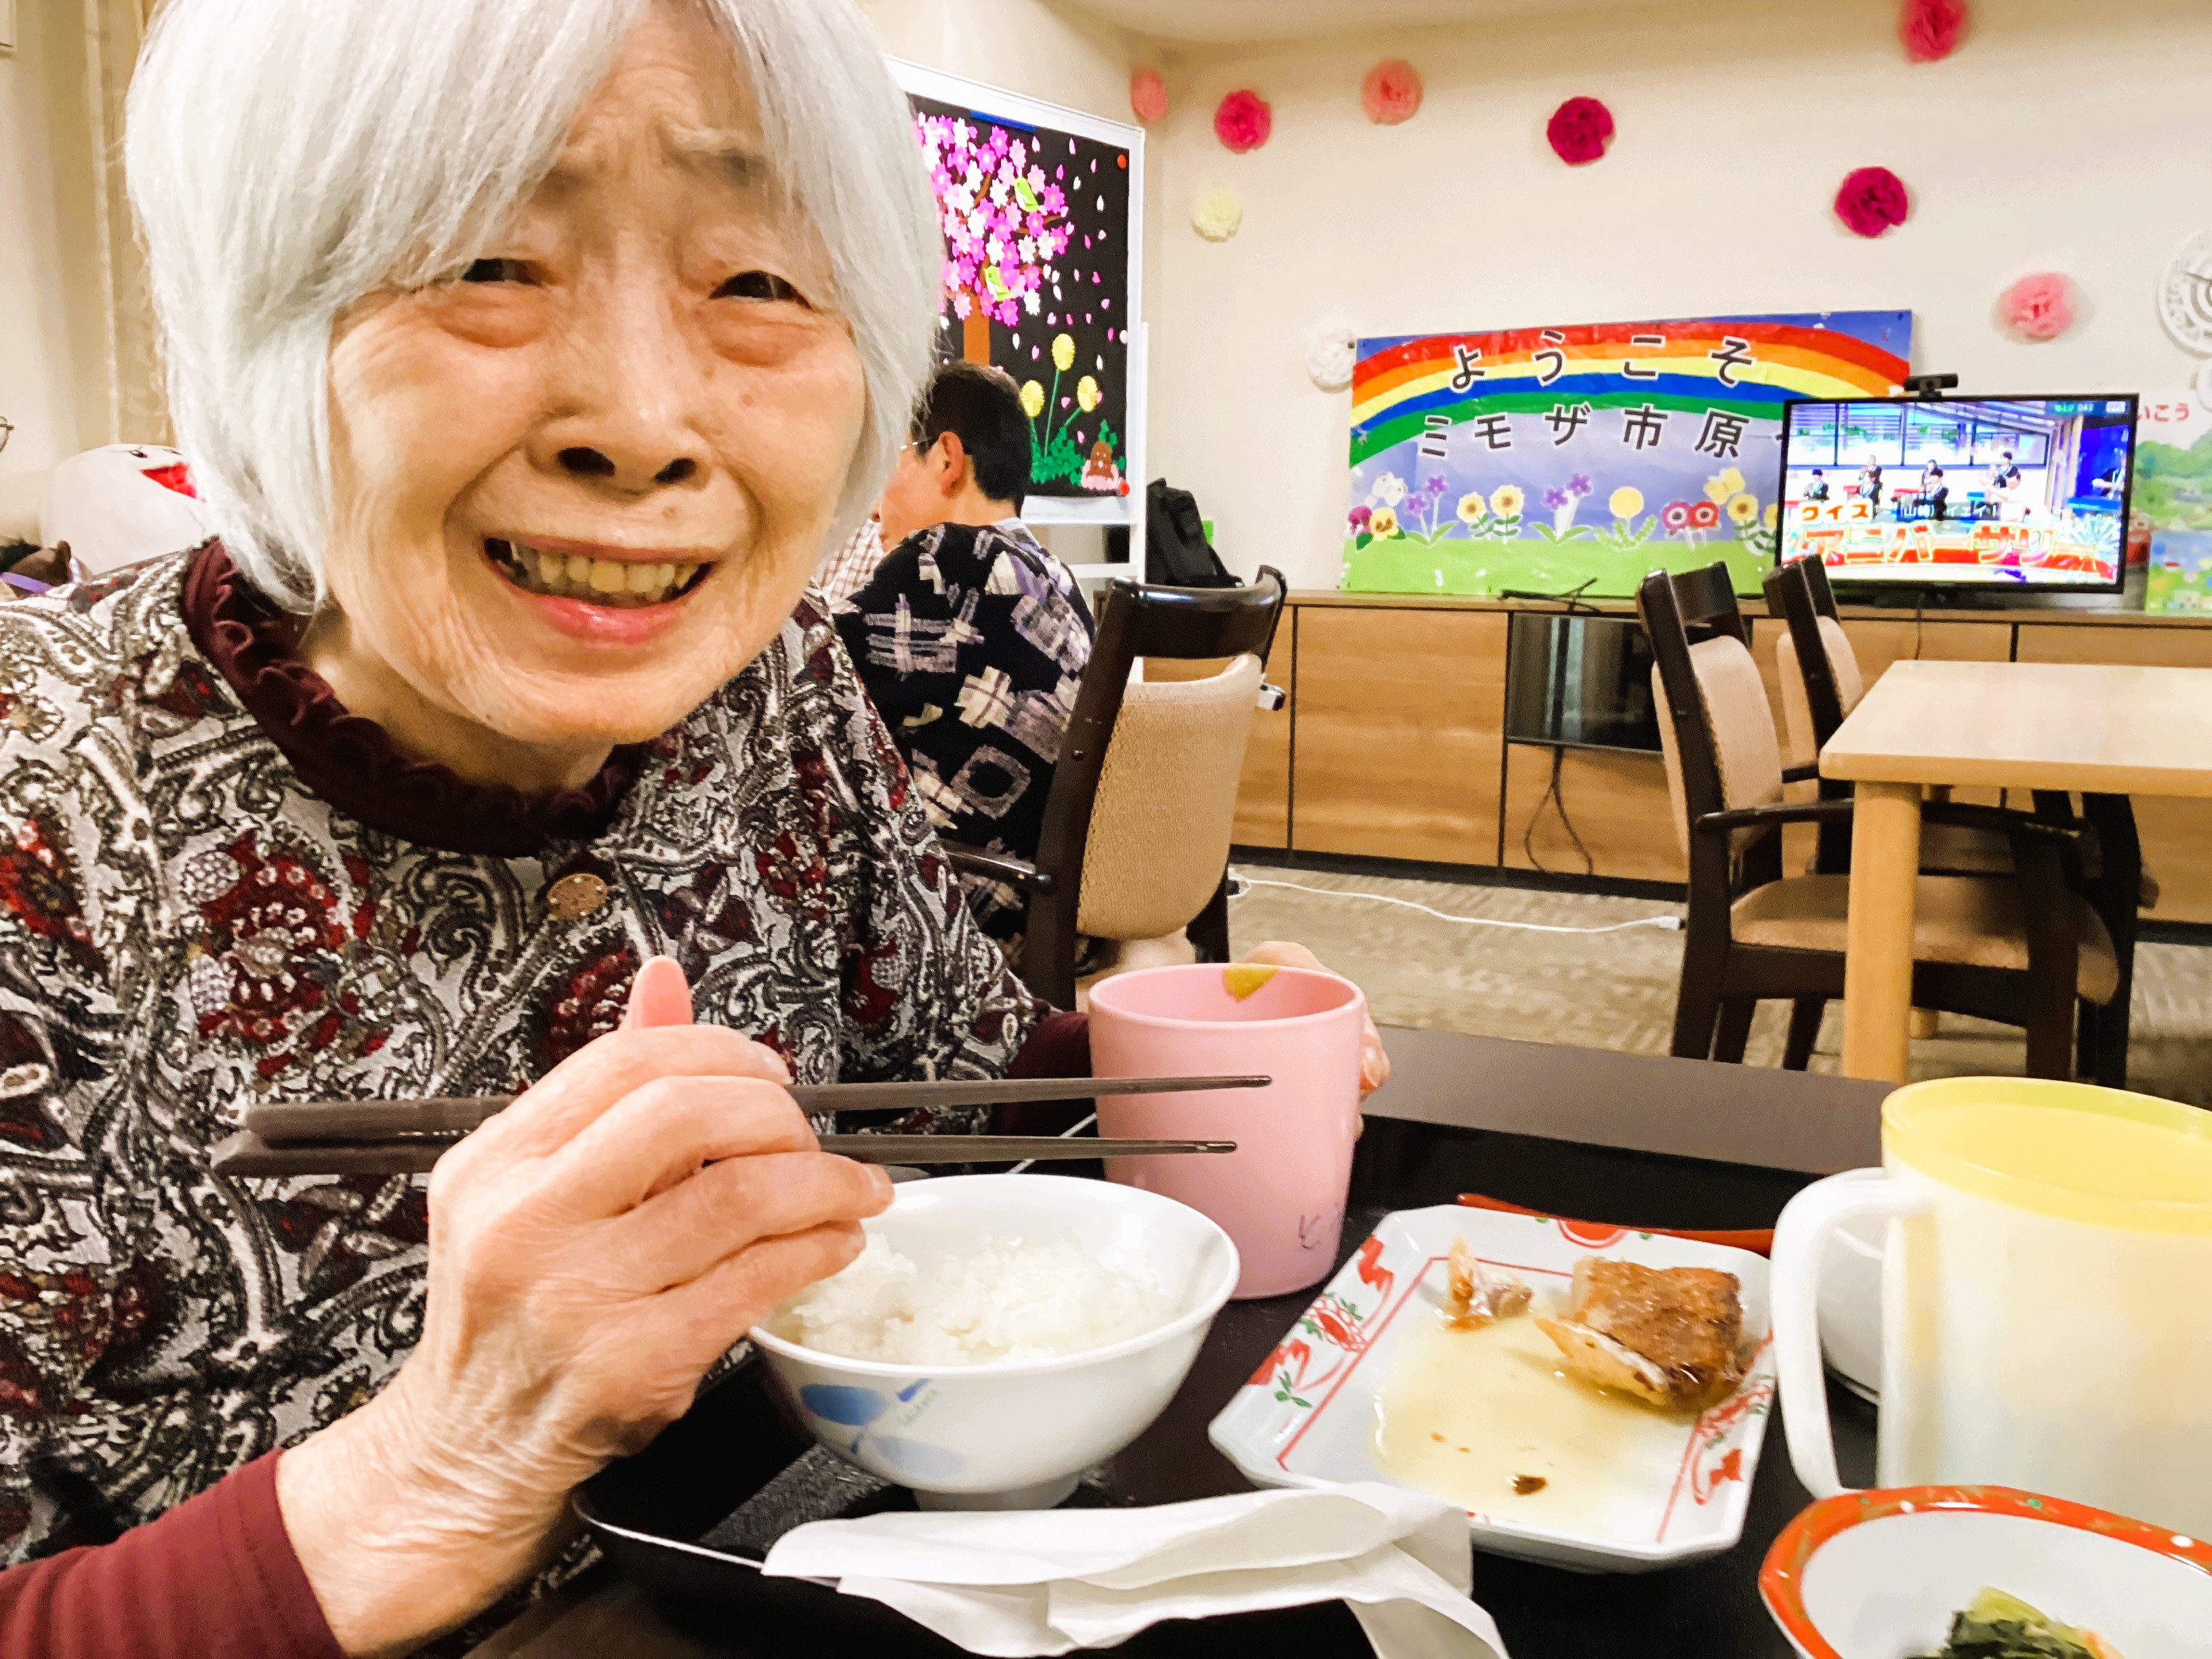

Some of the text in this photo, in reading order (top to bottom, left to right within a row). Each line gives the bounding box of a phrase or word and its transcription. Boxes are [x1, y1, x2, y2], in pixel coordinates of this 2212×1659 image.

[1450, 331, 1755, 391] ようこそ
[1422, 403, 1782, 458] ミモザ市原
[1803, 523, 2097, 565] アニバーサリー
